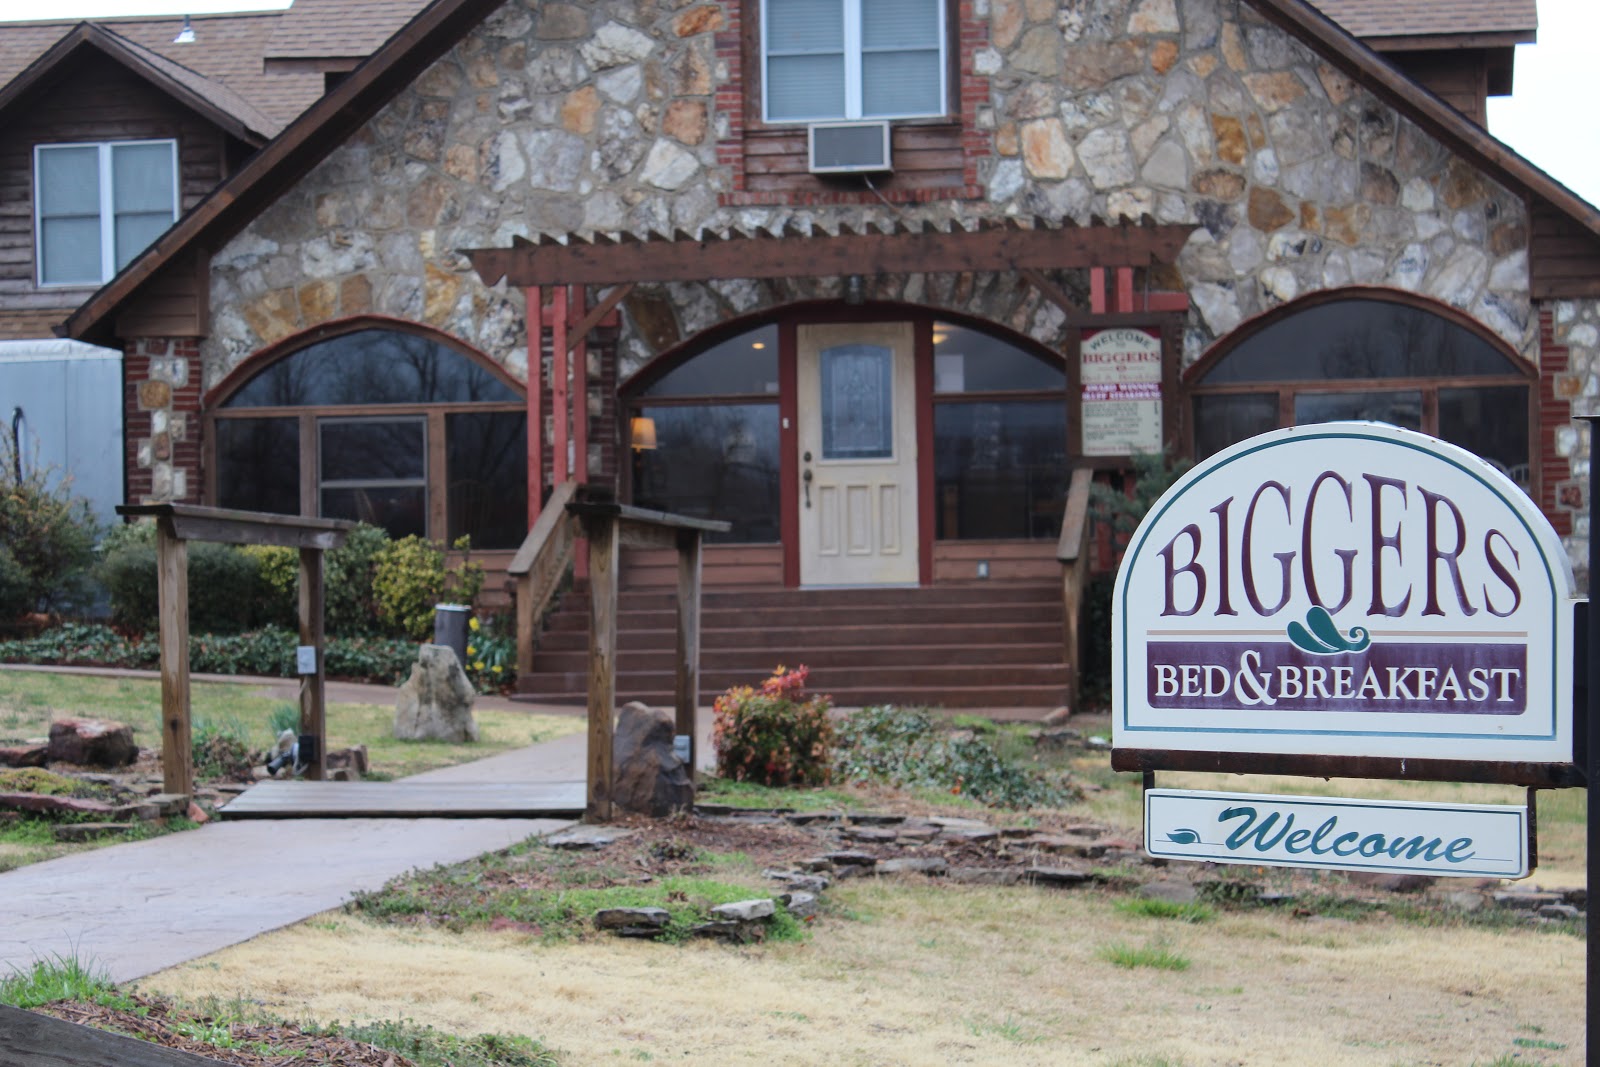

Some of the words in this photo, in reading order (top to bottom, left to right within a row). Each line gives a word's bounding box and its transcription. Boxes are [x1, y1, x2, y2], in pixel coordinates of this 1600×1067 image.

[1082, 351, 1160, 364] BIGGERS
[1090, 330, 1152, 350] WELCOME
[1155, 470, 1522, 617] BIGGERS
[1218, 806, 1476, 864] Welcome
